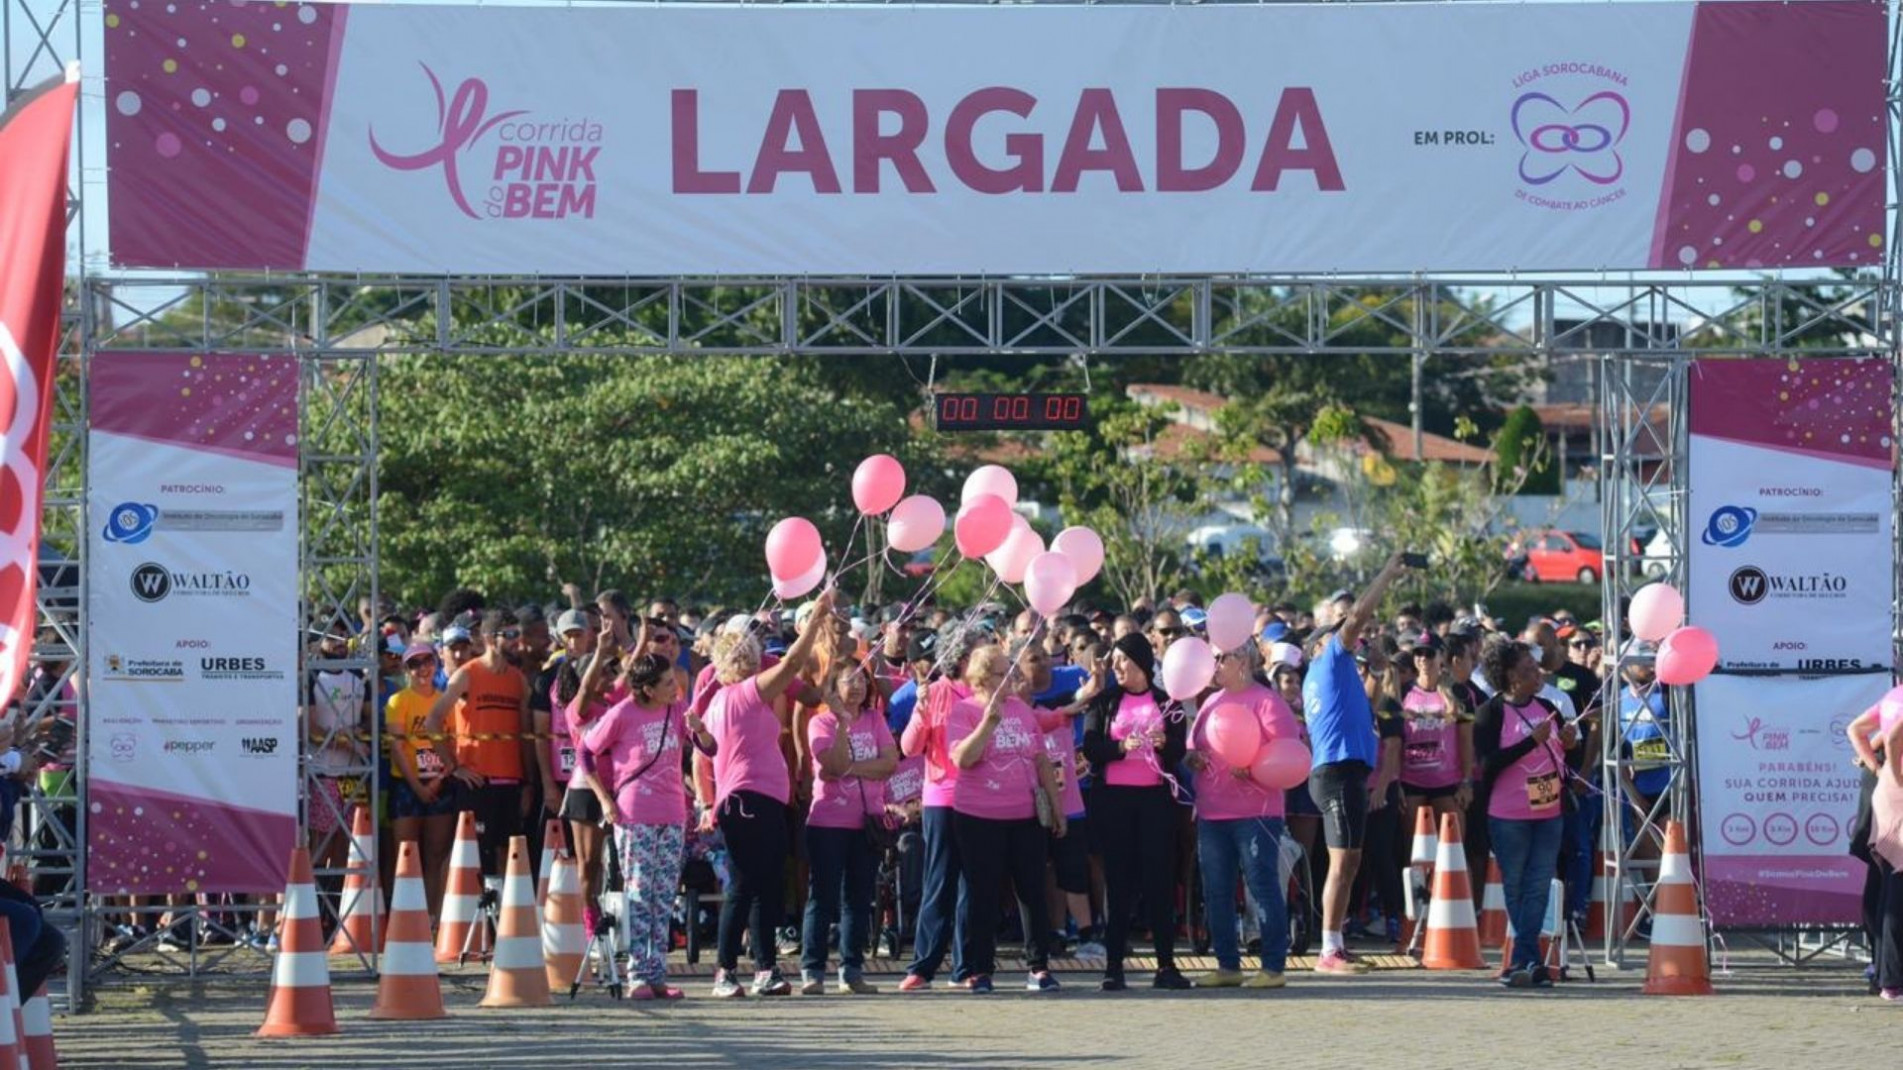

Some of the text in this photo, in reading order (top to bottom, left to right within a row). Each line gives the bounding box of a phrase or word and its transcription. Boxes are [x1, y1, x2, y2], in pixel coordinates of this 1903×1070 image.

[1512, 62, 1629, 89] LIGA SOROCABANA
[499, 117, 603, 142] corrida
[671, 86, 1347, 195] LARGADA
[1413, 130, 1496, 146] EM PROL:
[493, 145, 603, 181] PINK
[502, 183, 597, 219] BEM
[942, 396, 1080, 421] 00 00 00
[161, 483, 226, 494] PATROCÍNIO:
[1759, 487, 1824, 497] PATROCÍNIO:
[172, 570, 250, 590] WALTÃO
[1769, 572, 1847, 592] WALTÃO
[176, 640, 211, 648] APOIO:
[1773, 642, 1807, 650] APOIO:
[201, 657, 266, 671] URBES
[128, 668, 184, 676] SOROCABA
[1759, 761, 1837, 773] PARABÉNS!
[1538, 780, 1553, 793] 90
[1725, 778, 1862, 789] SUA CORRIDA AJUD
[1744, 792, 1854, 803] QUEM PRECISA!
